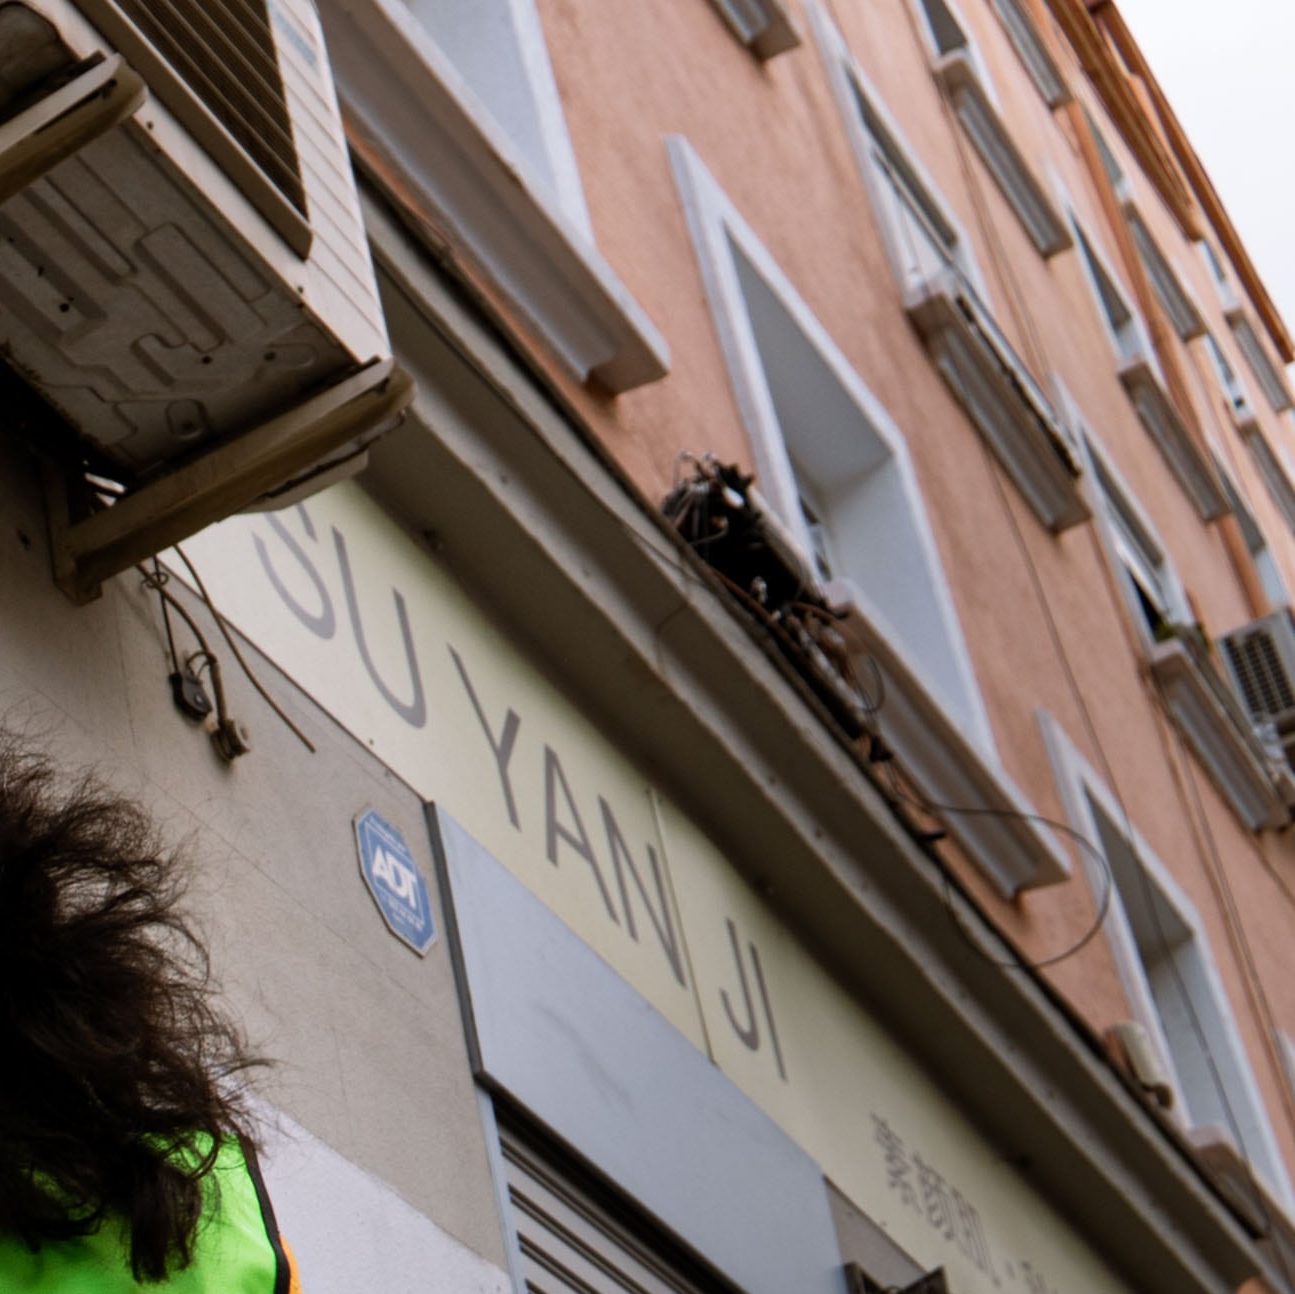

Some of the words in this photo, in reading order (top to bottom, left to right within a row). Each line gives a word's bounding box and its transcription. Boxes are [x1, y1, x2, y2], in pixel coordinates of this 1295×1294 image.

[252, 502, 427, 729] SU
[446, 641, 687, 990] YAN
[719, 917, 788, 1083] JI
[372, 845, 418, 910] ADT
